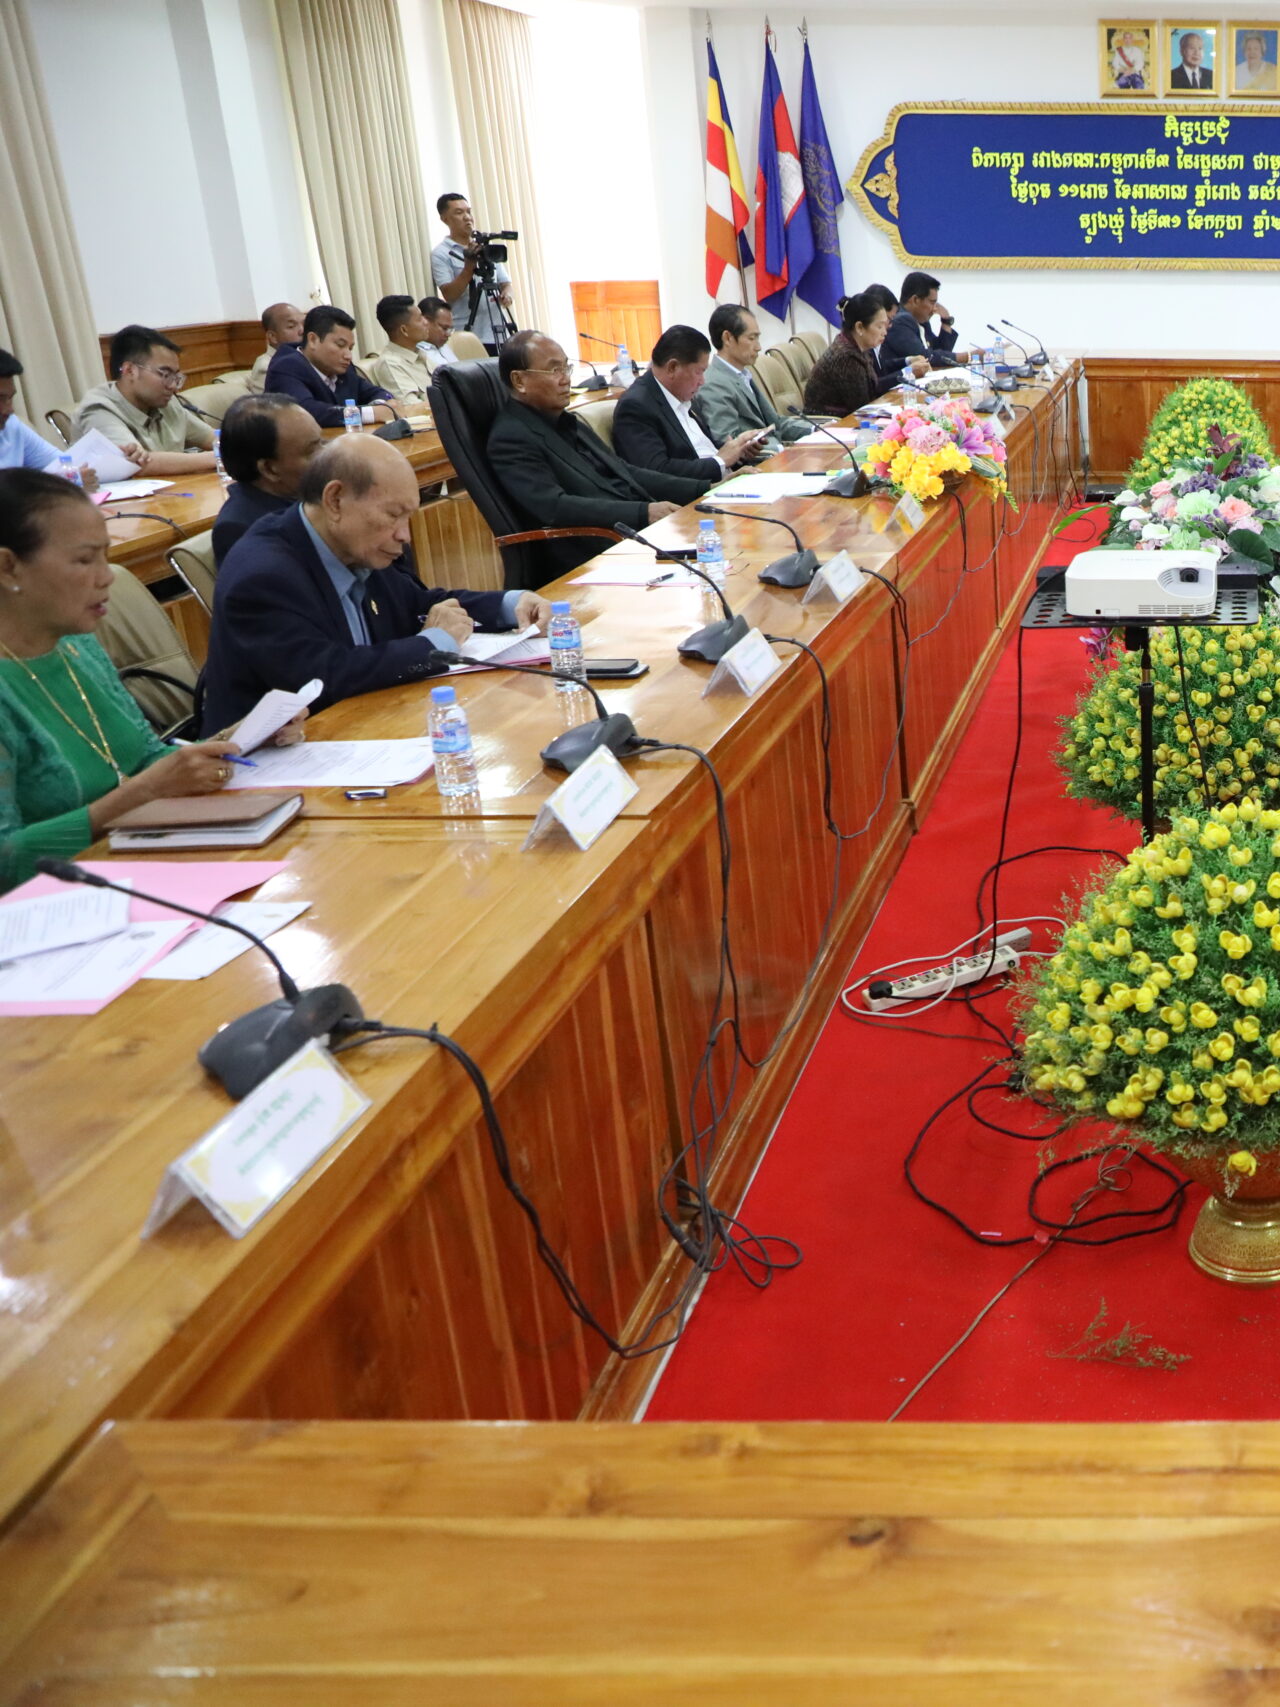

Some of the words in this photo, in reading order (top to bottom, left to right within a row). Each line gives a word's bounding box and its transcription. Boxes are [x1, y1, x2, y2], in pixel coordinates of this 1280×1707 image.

[1165, 115, 1230, 145] កិច្ចប្រជុំ
[972, 147, 1024, 176] ពិភាក្សា
[1176, 146, 1244, 177] នៃរដ្ឋសភា
[1010, 176, 1051, 205] ថ្ងៃពុធ
[1079, 207, 1124, 243] ត្បូងឃ្មុំ
[1130, 206, 1181, 234] ថ្ងៃទី៣១
[1187, 208, 1242, 238] ខែកក្កដា
